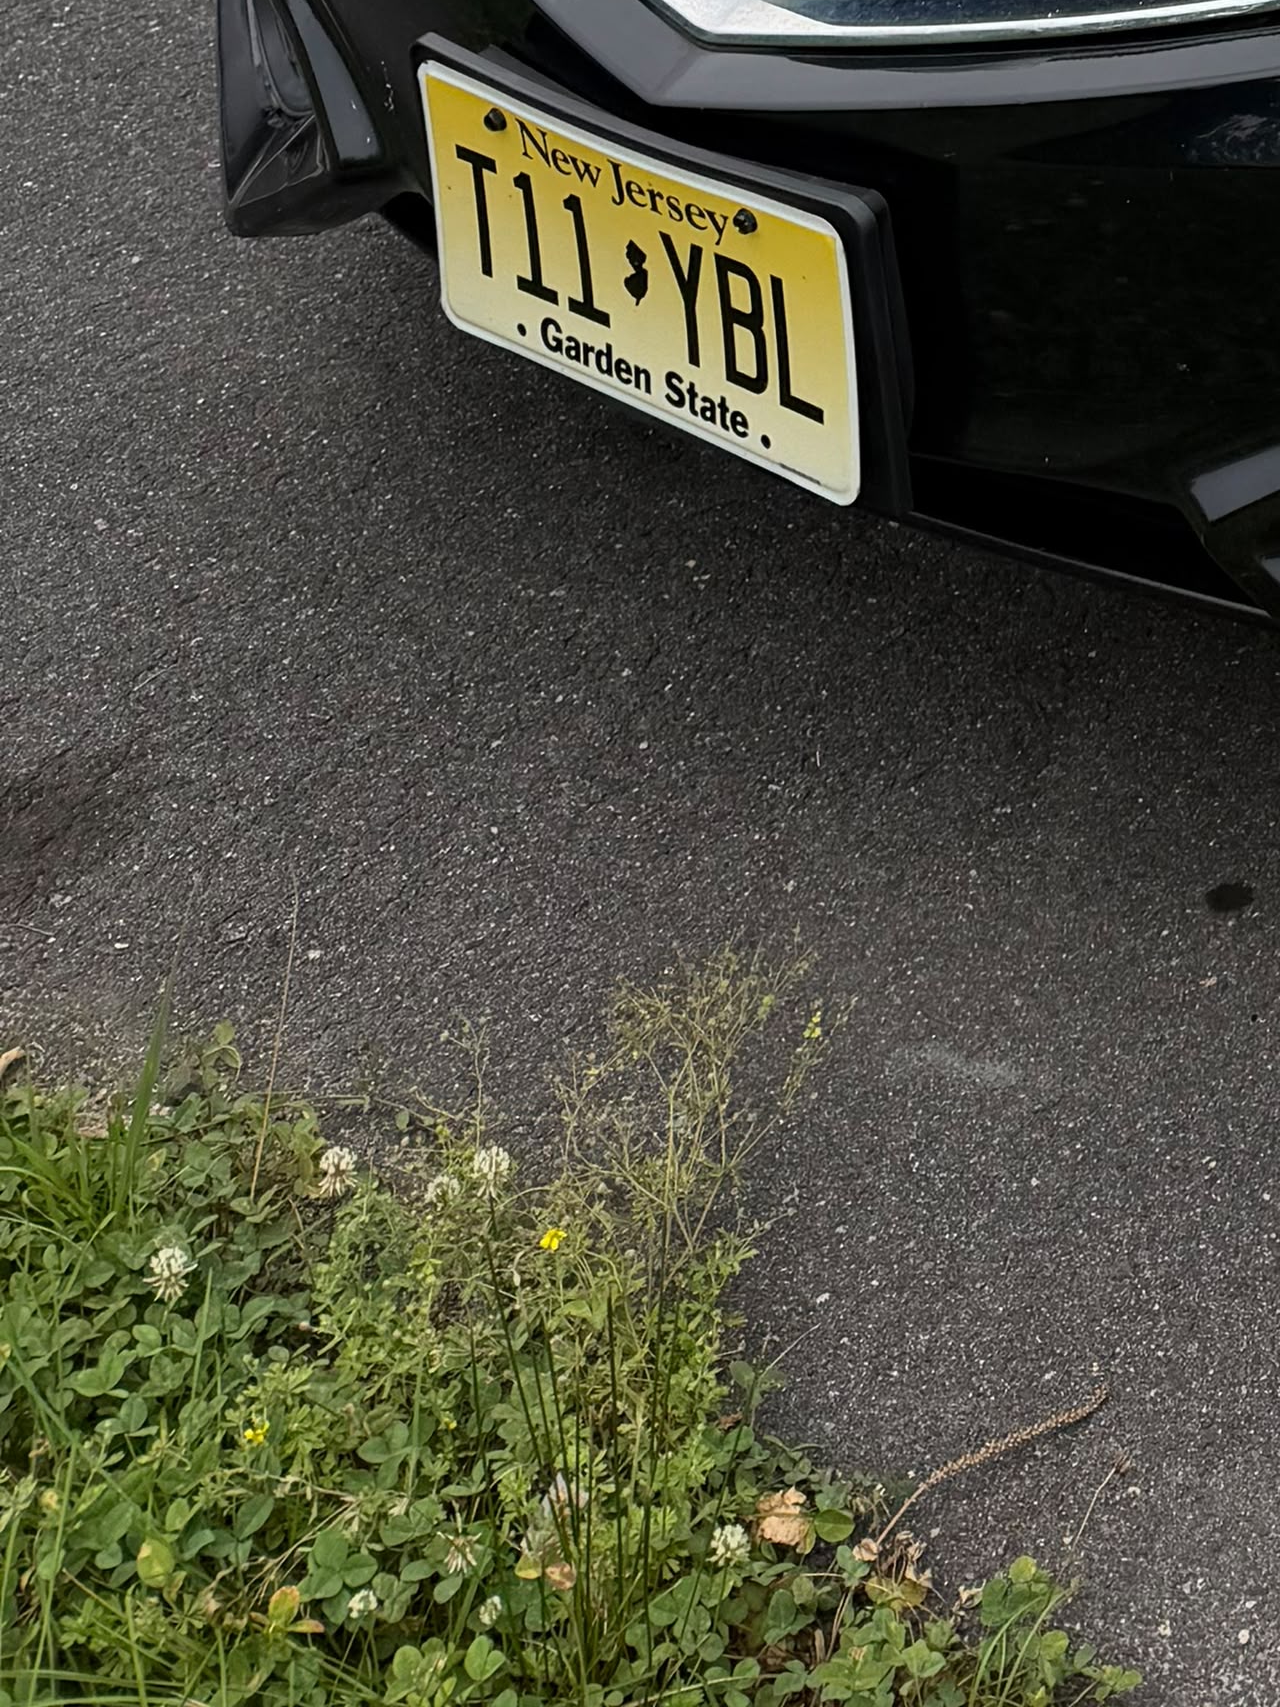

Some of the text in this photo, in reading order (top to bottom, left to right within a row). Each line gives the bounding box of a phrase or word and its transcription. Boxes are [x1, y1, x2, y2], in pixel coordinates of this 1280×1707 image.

[515, 118, 729, 246] New Jersey
[455, 143, 825, 425] T11 YBL
[540, 316, 750, 439] Garden State
